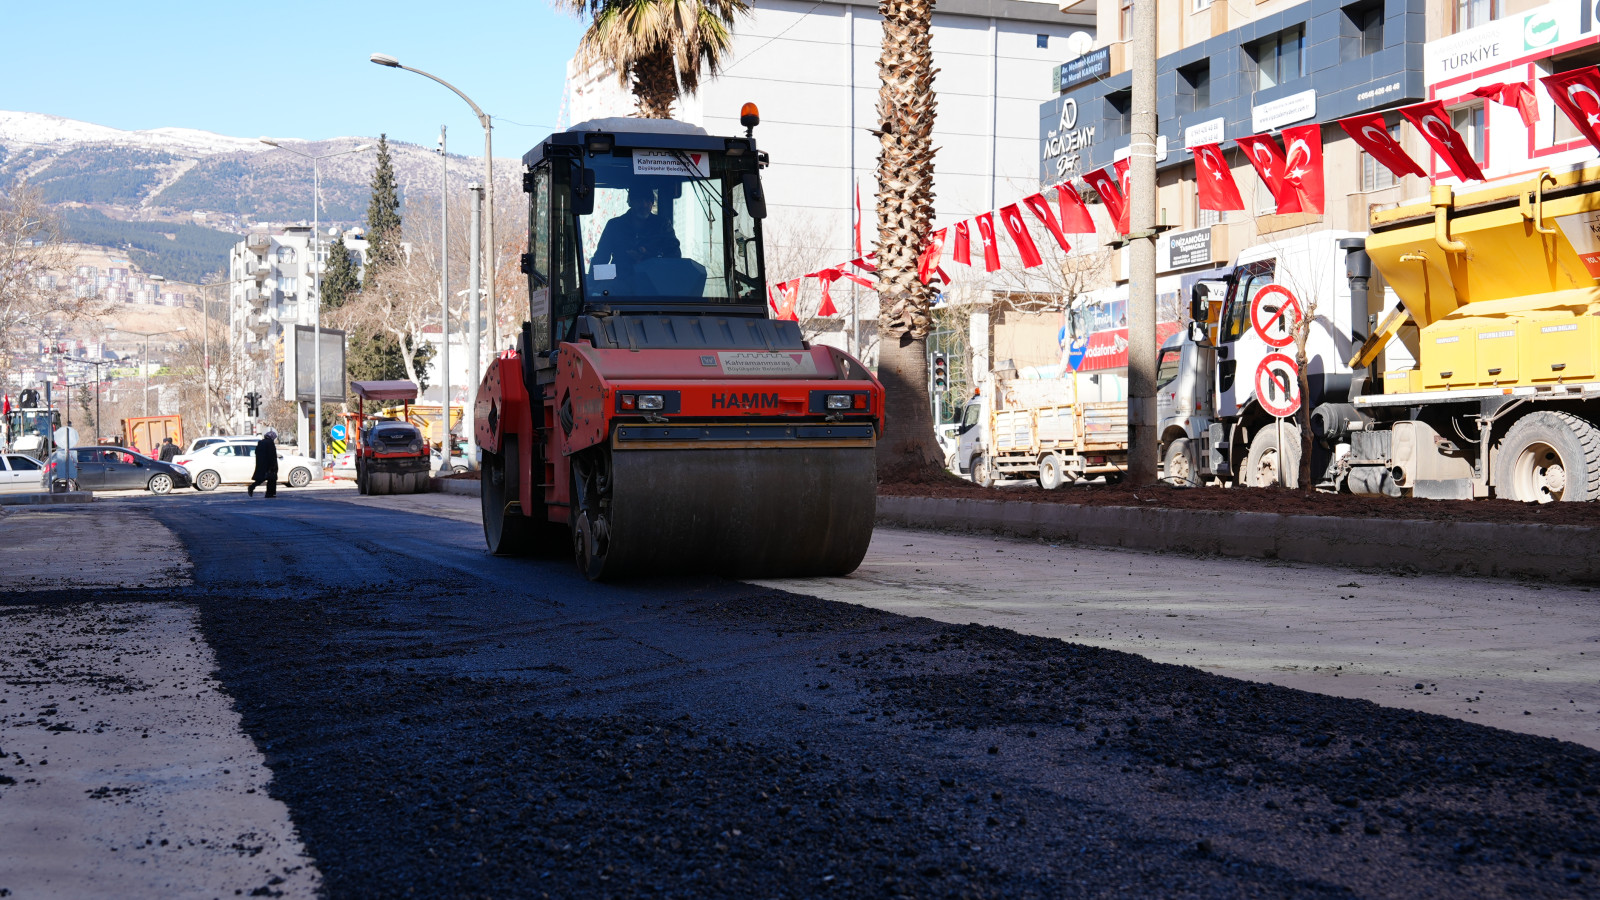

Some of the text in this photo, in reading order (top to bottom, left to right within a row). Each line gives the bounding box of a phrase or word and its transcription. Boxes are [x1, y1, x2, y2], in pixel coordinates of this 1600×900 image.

[1441, 43, 1500, 72] TÜRKİYE
[1044, 126, 1096, 160] ACADEMY
[637, 159, 691, 168] Kahramanmaş
[1084, 344, 1117, 358] vodafone
[711, 393, 779, 409] HAMM
